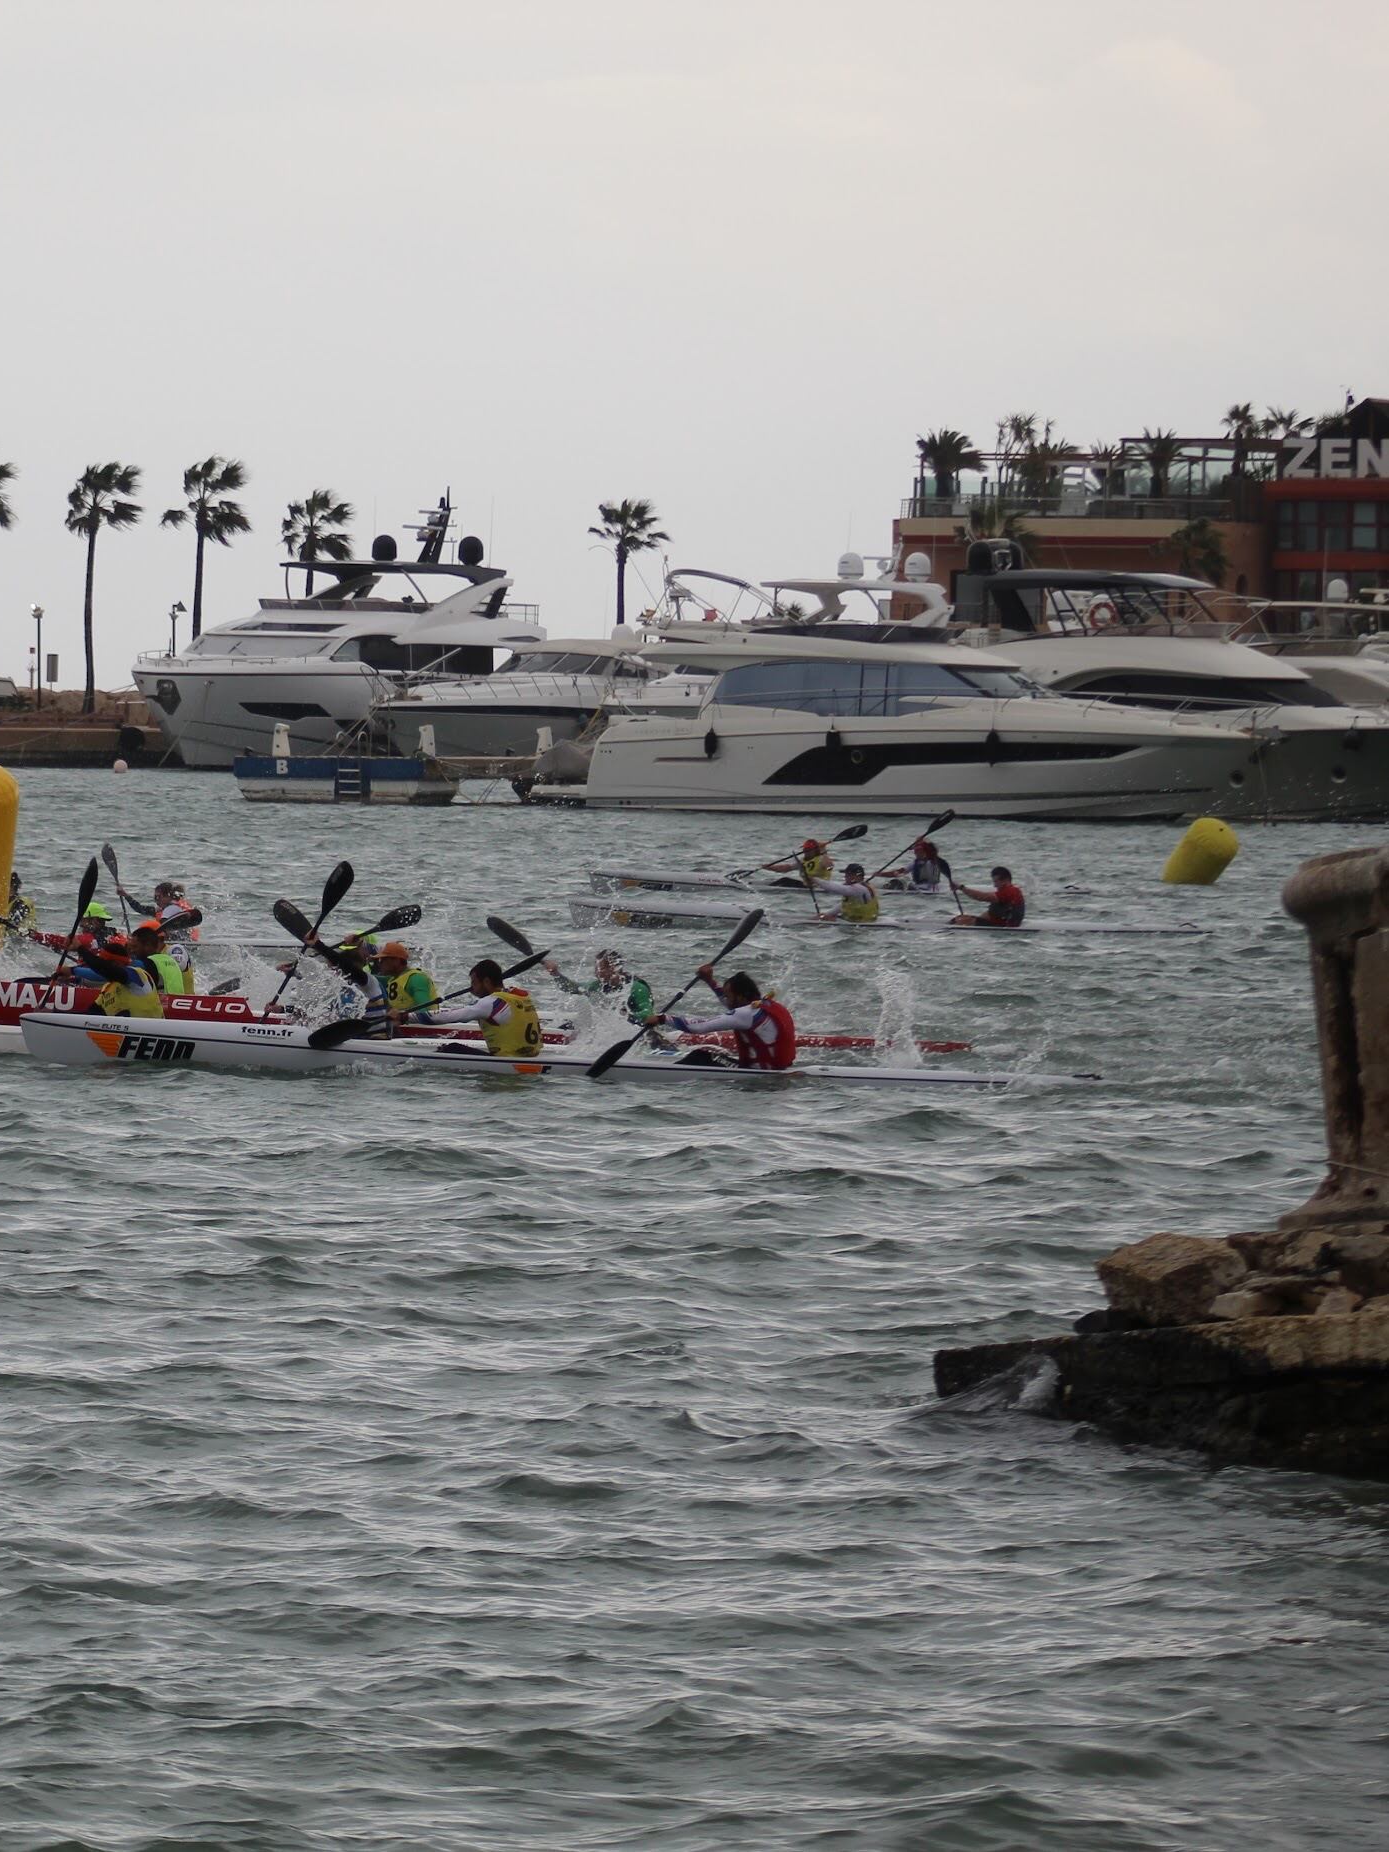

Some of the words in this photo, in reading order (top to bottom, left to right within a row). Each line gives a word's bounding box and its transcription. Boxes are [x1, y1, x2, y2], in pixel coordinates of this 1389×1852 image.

[1283, 438, 1389, 478] ZEN
[276, 760, 289, 774] B
[171, 998, 246, 1014] ELIO
[241, 1026, 295, 1038] fenn.fr
